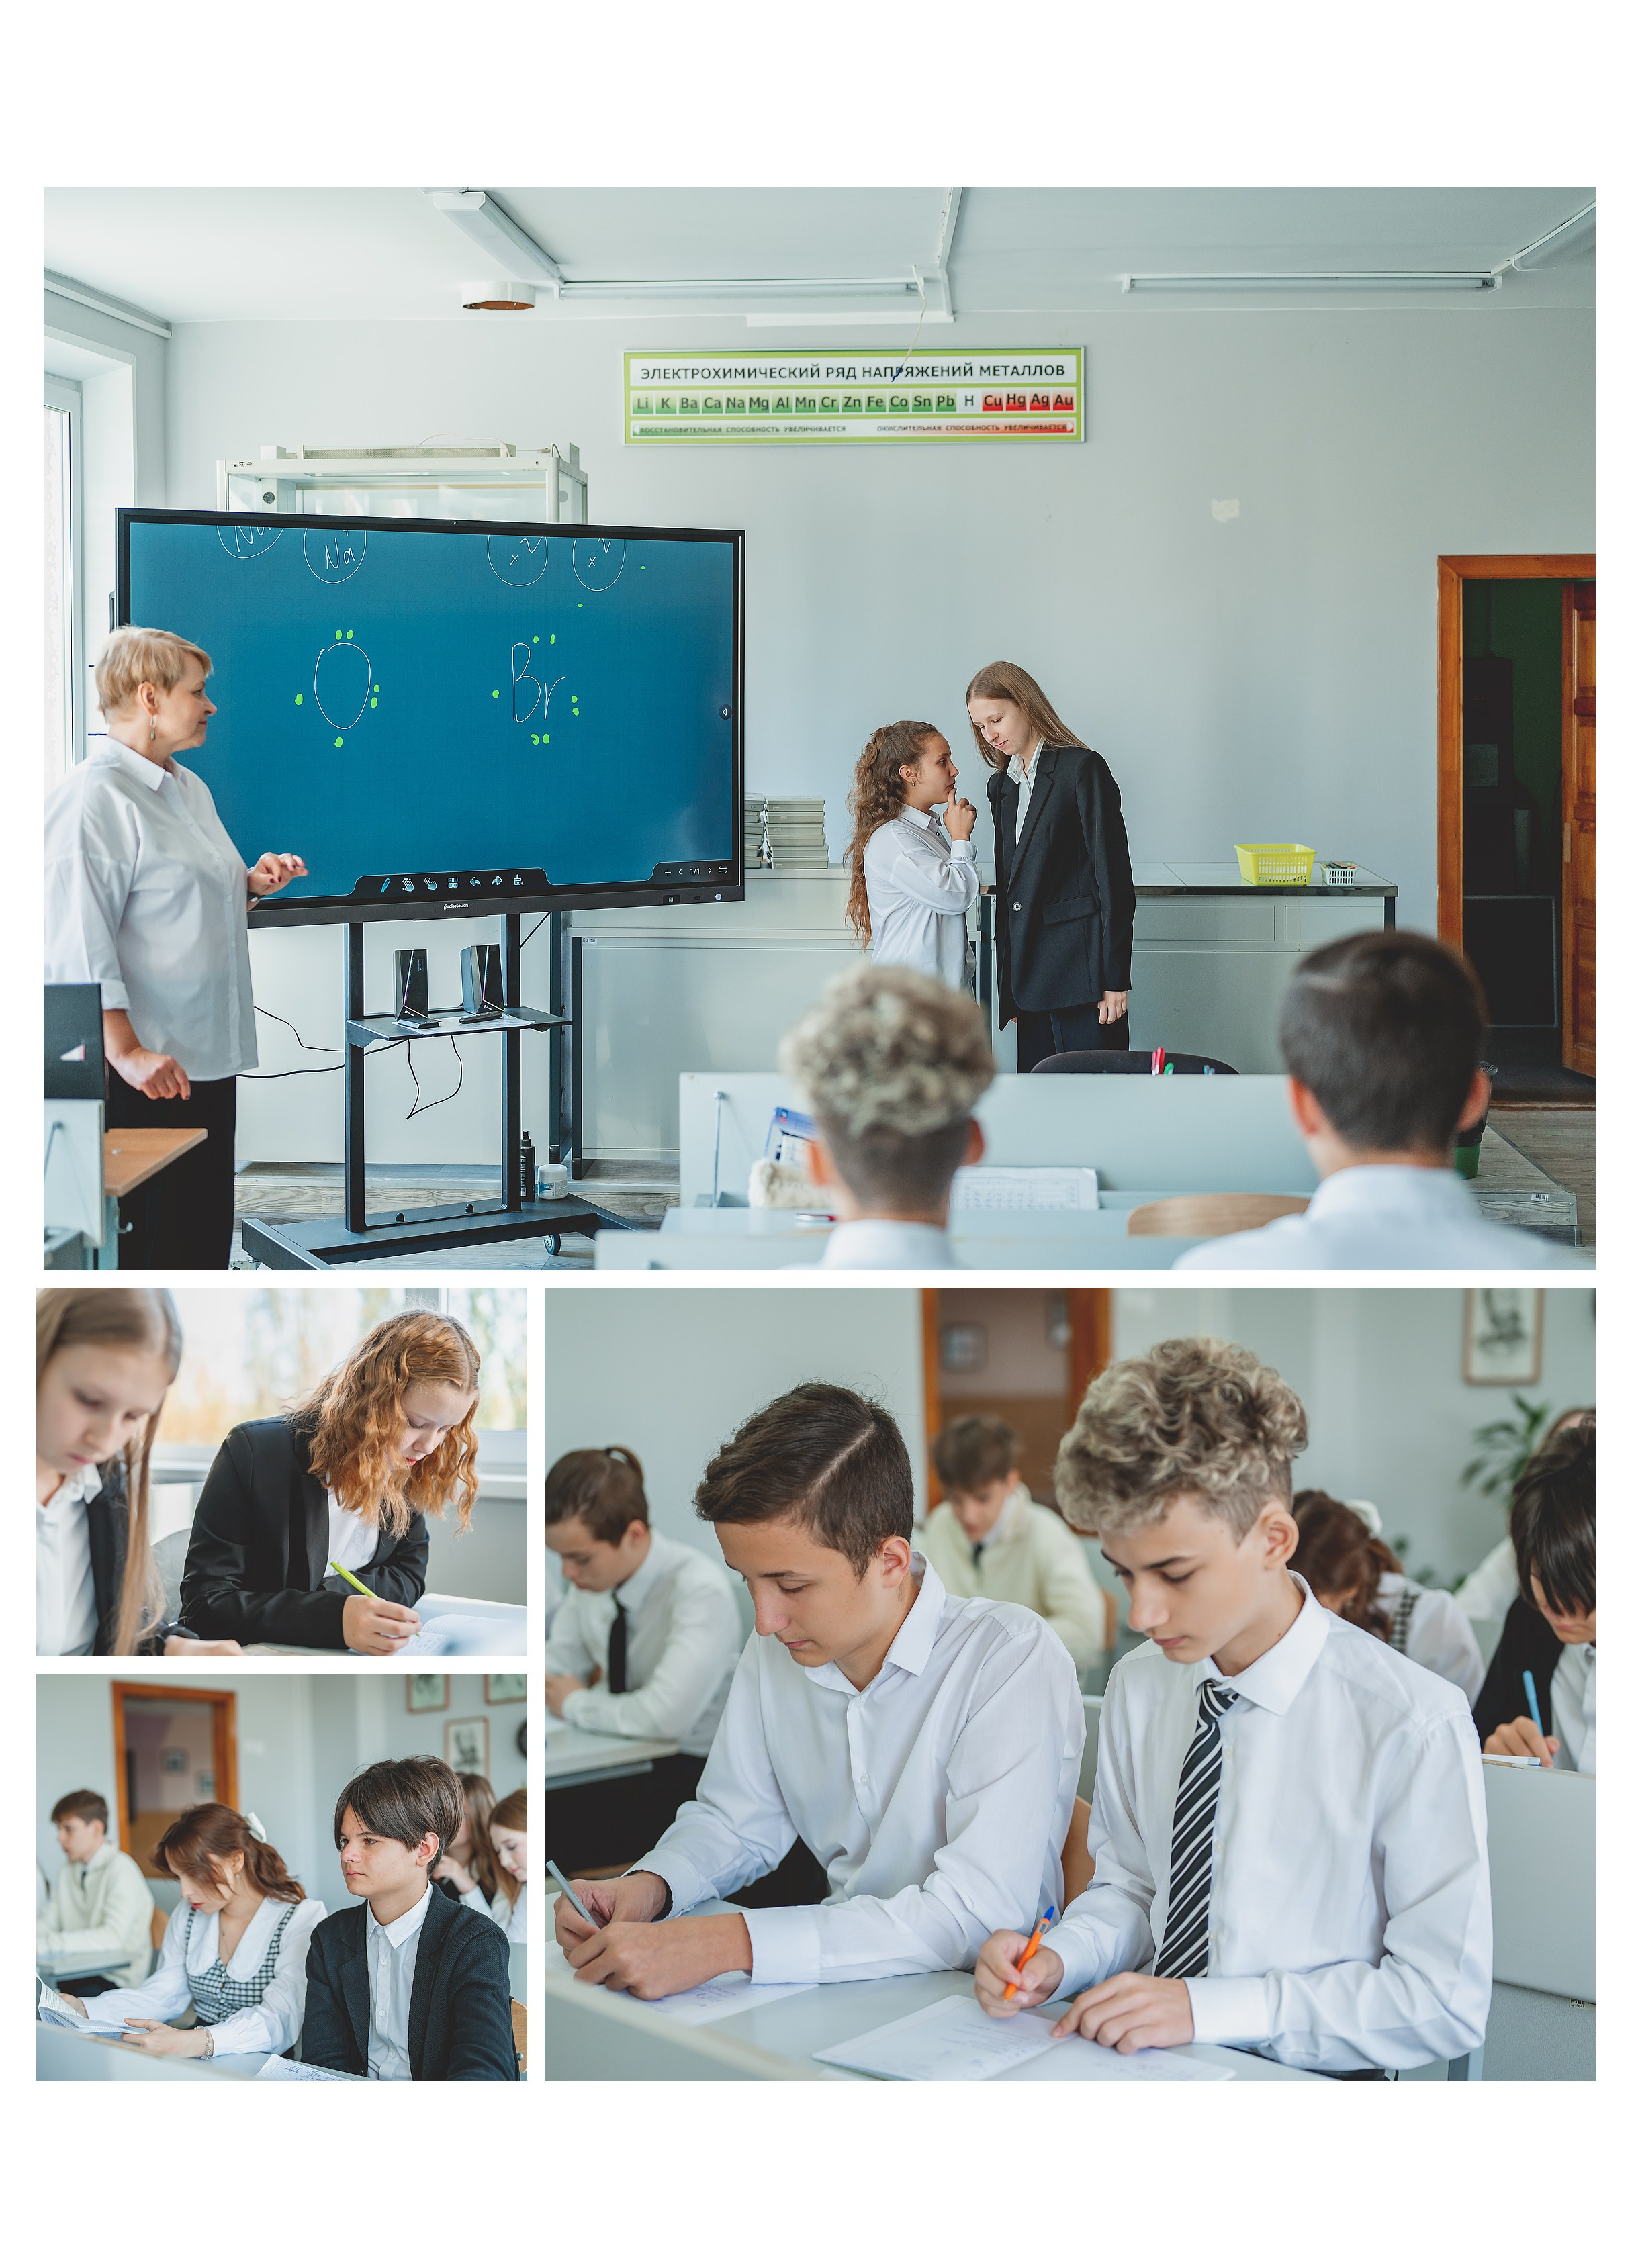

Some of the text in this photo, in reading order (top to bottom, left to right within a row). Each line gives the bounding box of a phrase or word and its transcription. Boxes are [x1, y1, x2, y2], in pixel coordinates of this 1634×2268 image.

[641, 363, 819, 379] ЭЛЕКТРОХИМИЧЕСКИЙ
[826, 367, 856, 380] РЯД
[979, 365, 1065, 377] МЕТАЛЛОВ
[637, 393, 1073, 410] Li K Ba Ca Na Mg Al Mn Cr Zn Fe Co Sn Pb H Cu Hg Ag Au
[325, 538, 356, 569] Na
[511, 643, 566, 723] Br
[690, 867, 700, 876] 1/1
